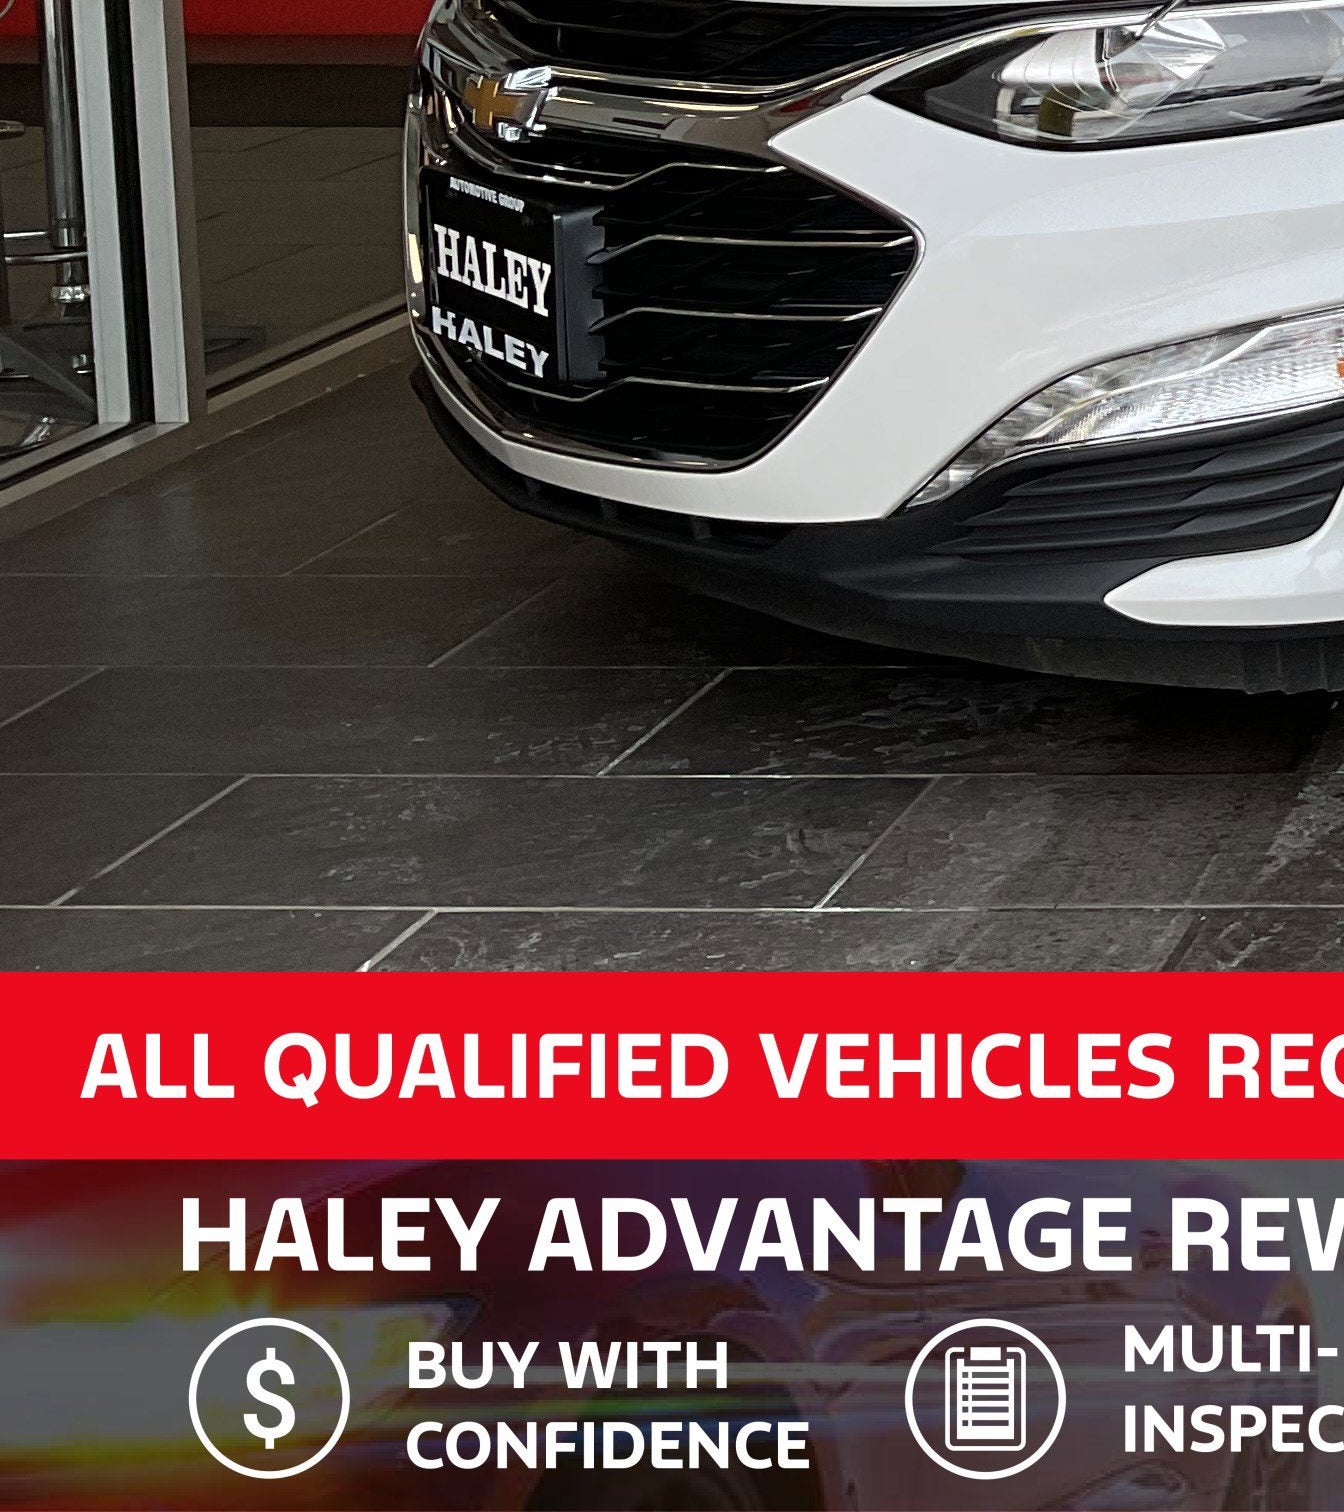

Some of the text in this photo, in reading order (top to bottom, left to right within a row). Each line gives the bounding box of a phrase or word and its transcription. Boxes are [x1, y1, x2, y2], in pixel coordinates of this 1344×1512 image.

[450, 176, 525, 213] AUTOMOTIVE GROUP
[434, 223, 551, 317] HALEY
[432, 305, 550, 378] HALEY
